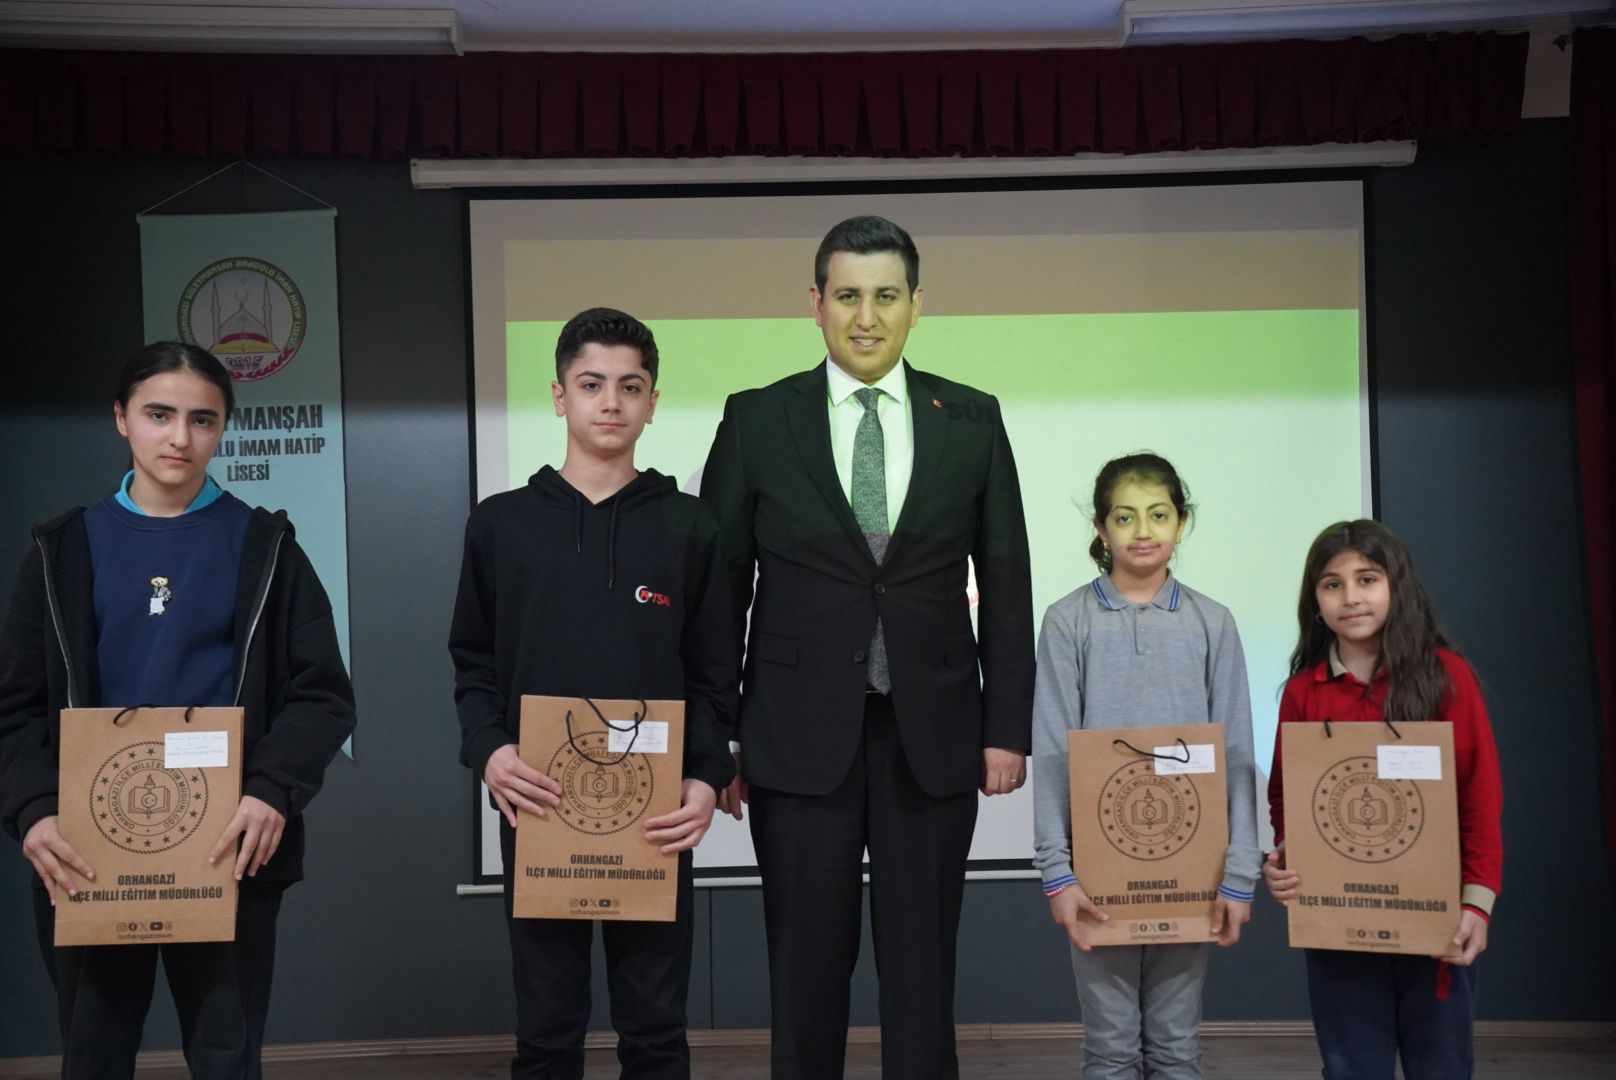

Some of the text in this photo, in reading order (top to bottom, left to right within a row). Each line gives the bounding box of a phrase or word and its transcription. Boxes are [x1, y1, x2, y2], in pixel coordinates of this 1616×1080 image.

[225, 404, 323, 433] MANŞAH
[239, 435, 281, 456] İMAM
[284, 433, 326, 455] HATİP
[227, 459, 270, 482] LİSESİ
[156, 762, 181, 780] ETİM
[570, 854, 623, 865] ORHANGAZİ
[117, 872, 175, 886] ORHANGAZİ
[526, 865, 666, 880] İLÇE MİLLİ EĞİTİM MÜDÜRLÜĞÜ
[1127, 879, 1178, 891] ORHANGAZİ
[1344, 882, 1399, 895] ORHANGAZİ
[92, 888, 119, 901] MİLLİ
[121, 887, 156, 901] EĞİTİM
[159, 886, 223, 900] MÜDÜRLÜĞÜ
[1106, 894, 1130, 905] MİLLİ
[1131, 892, 1162, 904] EĞİTİM
[1299, 895, 1448, 912] İLÇE MİLLİ EĞİTİM MÜDÜRLÜĞÜ
